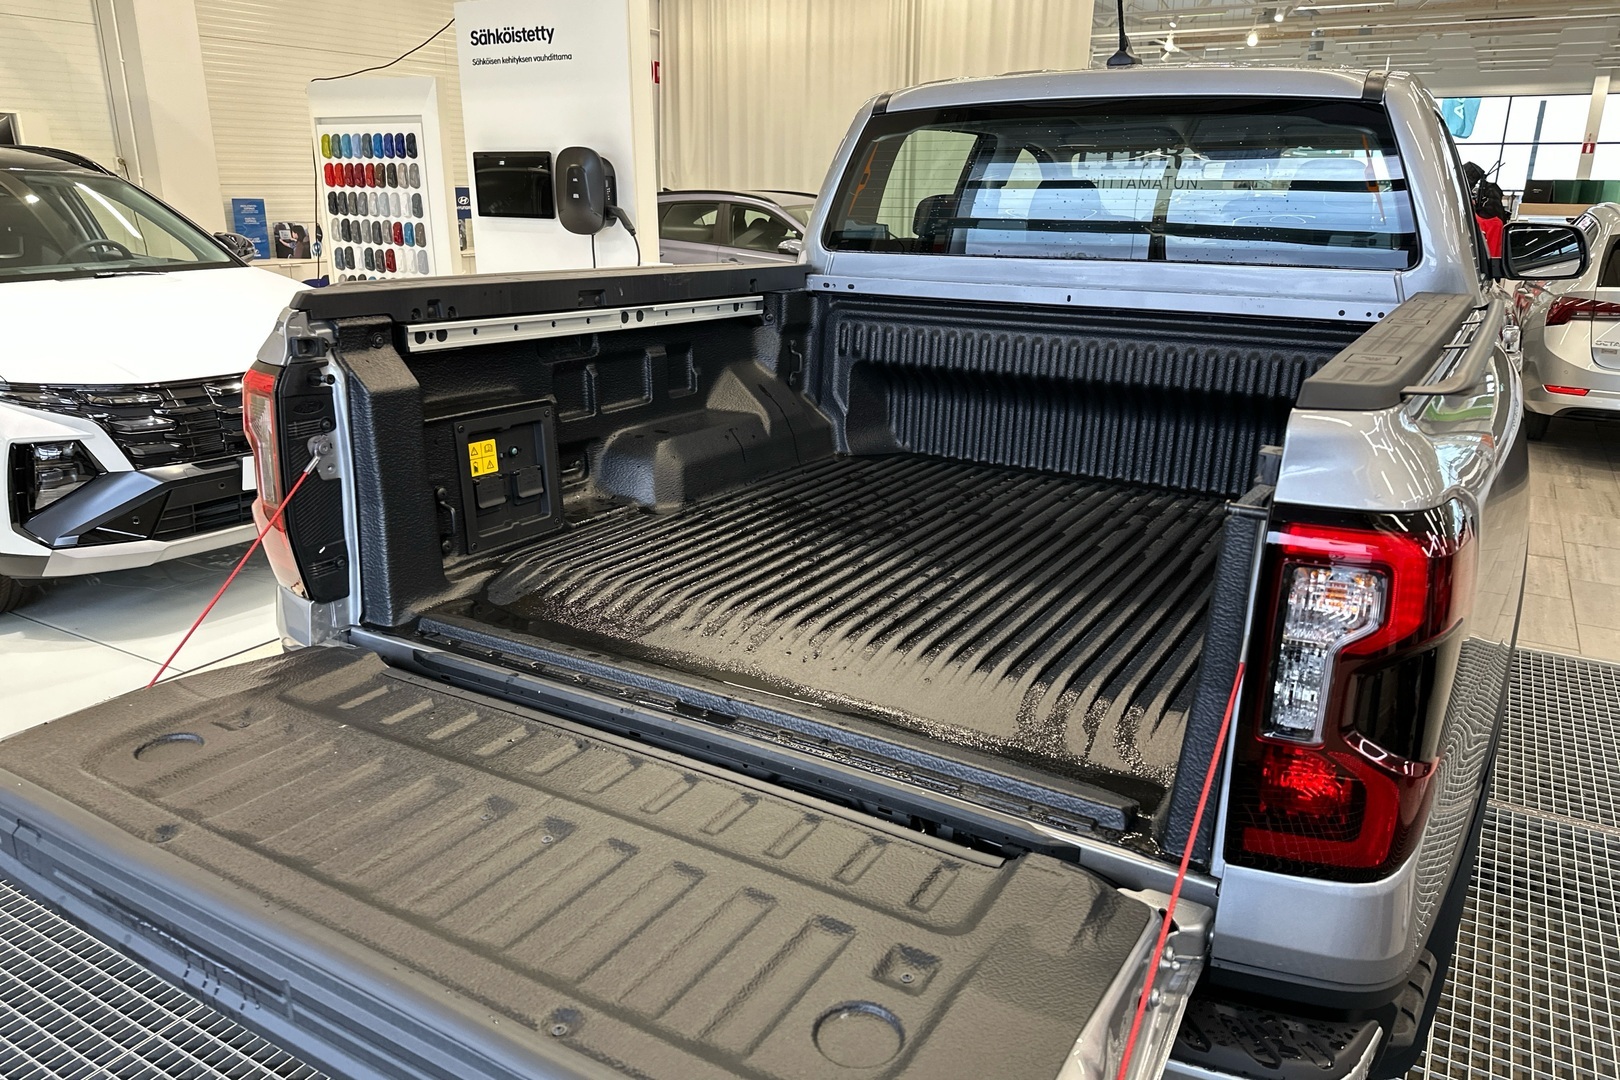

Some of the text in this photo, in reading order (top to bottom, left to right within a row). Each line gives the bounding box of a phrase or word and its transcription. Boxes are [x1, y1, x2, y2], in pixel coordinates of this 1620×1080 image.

[470, 25, 555, 46] Sähköistetty
[472, 53, 572, 66] Sähköisen kehityksen vauhdittama
